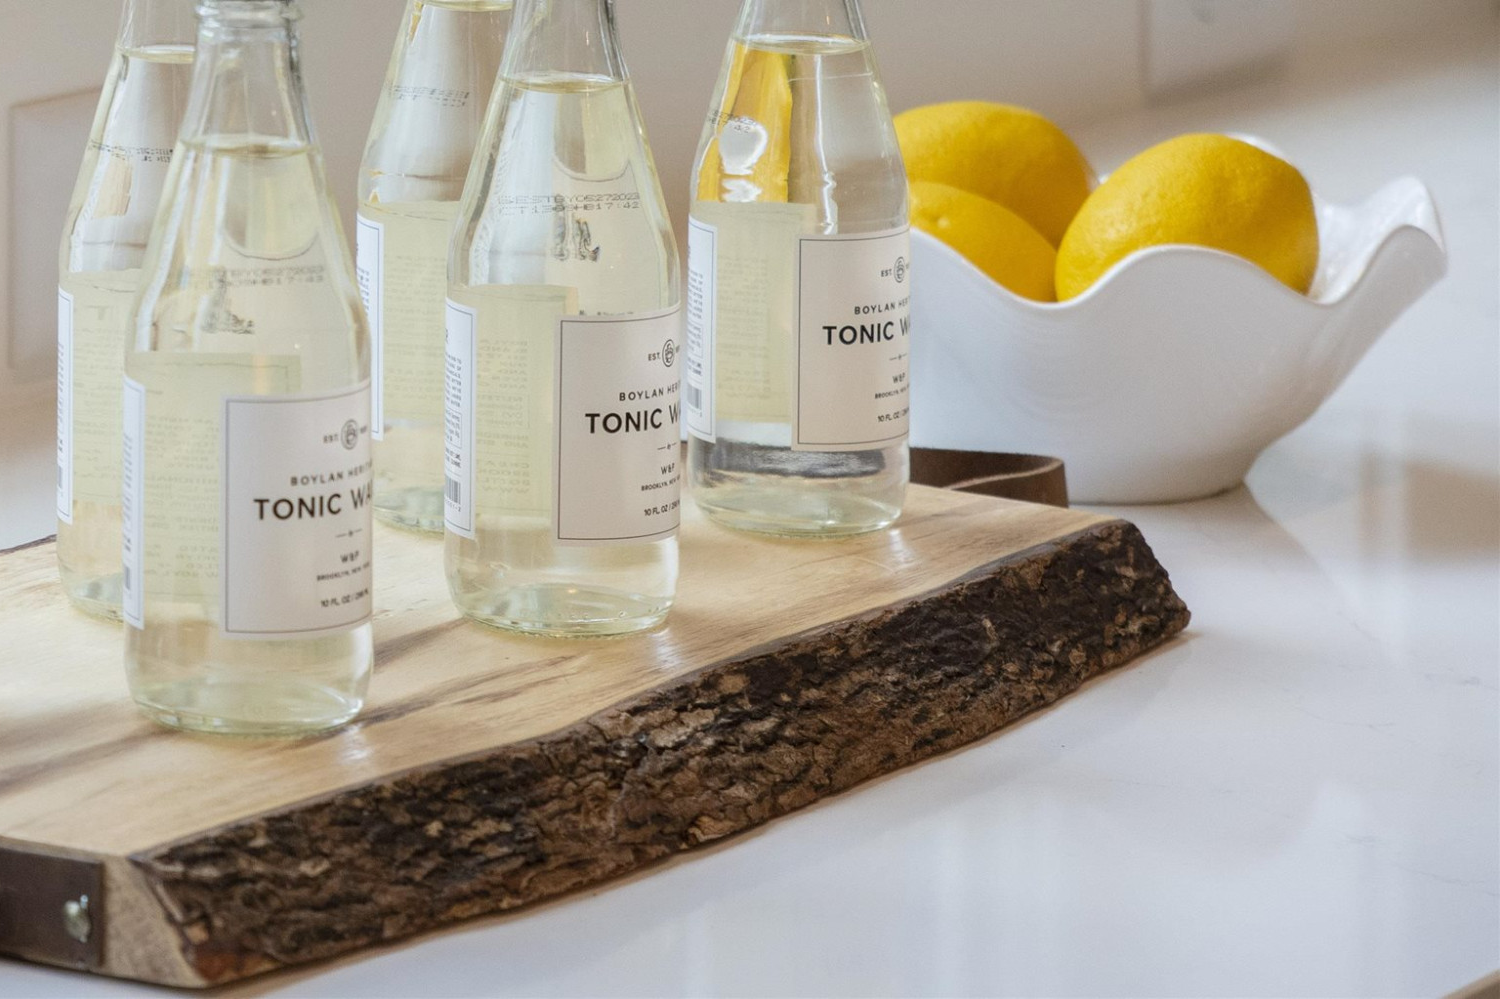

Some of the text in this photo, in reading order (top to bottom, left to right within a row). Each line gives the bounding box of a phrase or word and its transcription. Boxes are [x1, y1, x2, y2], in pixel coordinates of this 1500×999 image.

[854, 301, 896, 315] BOYLAN
[822, 321, 894, 345] TONIC
[619, 387, 664, 401] BOYLAN
[585, 408, 662, 434] TONIC
[290, 471, 344, 487] BOYLAN
[253, 493, 341, 520] TONIC
